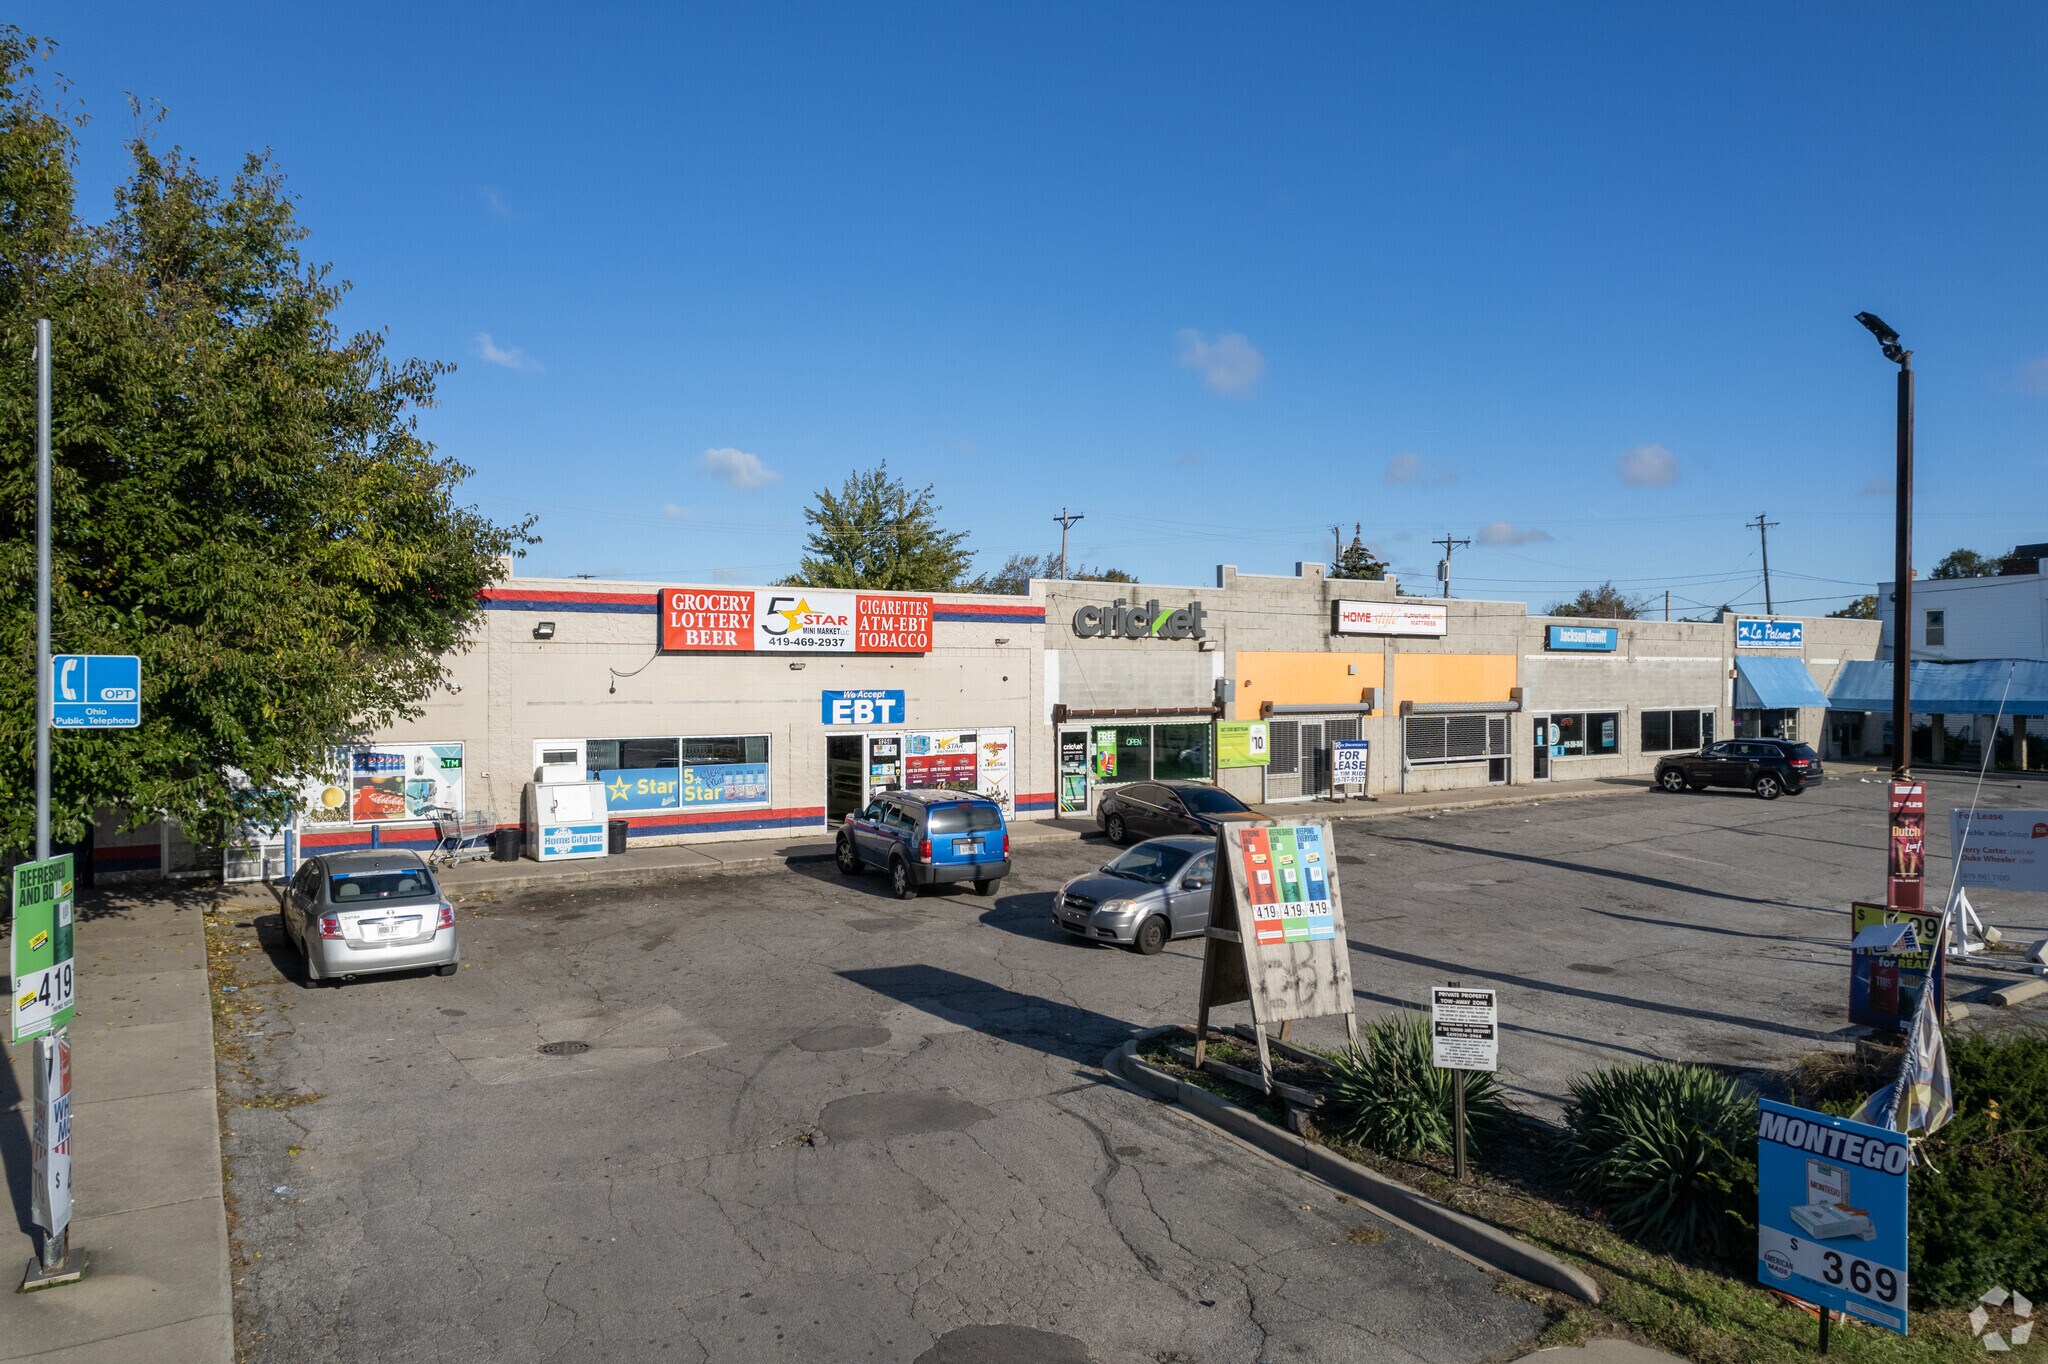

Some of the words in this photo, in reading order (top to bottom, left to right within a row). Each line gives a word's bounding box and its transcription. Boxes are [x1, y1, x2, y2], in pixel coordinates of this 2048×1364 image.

[672, 593, 750, 612] GROCERY
[860, 600, 929, 616] CIGARETTES
[671, 611, 751, 629] LOTTERY
[761, 597, 795, 635] 5
[803, 614, 848, 626] STAR
[1074, 598, 1207, 639] cricket
[1344, 612, 1371, 622] HOME
[1374, 607, 1402, 629] style
[859, 616, 926, 632] ATM-EBT
[686, 630, 738, 646] BEER
[816, 628, 841, 636] MARKET
[1560, 628, 1586, 642] Jackson
[1586, 630, 1606, 643] Hewitt
[1751, 624, 1762, 639] La
[1765, 624, 1791, 640] Paloma
[768, 637, 845, 647] 419-469-2937
[859, 632, 928, 648] TOBACCO
[105, 690, 132, 698] OPT
[858, 690, 886, 699] Accept
[832, 700, 896, 724] EBT
[88, 717, 135, 726] Telephone
[1098, 732, 1116, 740] FREE
[1252, 736, 1263, 749] $10
[1339, 751, 1360, 760] FOR
[440, 760, 459, 768] ATM
[1334, 761, 1366, 770] LEASE
[684, 768, 694, 784] 5
[701, 767, 725, 779] Clear
[637, 778, 676, 794] Star
[684, 785, 722, 801] Star
[1892, 826, 1921, 837] Dutch
[545, 836, 570, 845] Home
[571, 835, 588, 844] City
[1906, 841, 1921, 853] Leaf
[20, 862, 66, 888] REFRESHED
[1963, 872, 2010, 881] 419.861.1100
[19, 886, 40, 907] AND
[43, 880, 62, 902] BOLD
[1257, 905, 1276, 919] 4.19
[1284, 904, 1302, 917] 4.19
[1310, 902, 1327, 915] 4.19
[1858, 909, 1865, 920] $
[1879, 957, 1896, 967] for
[17, 979, 21, 988] $
[39, 964, 72, 1006] 4.19
[1876, 977, 1892, 986] THIS
[1759, 1111, 1907, 1175] MONTEGO
[56, 1172, 60, 1189] $
[1810, 1180, 1840, 1197] MONTEGO
[1764, 1253, 1793, 1270] AMERICAN
[1768, 1264, 1788, 1276] MADE
[1790, 1238, 1798, 1251] $
[1823, 1251, 1897, 1302] 3.69
